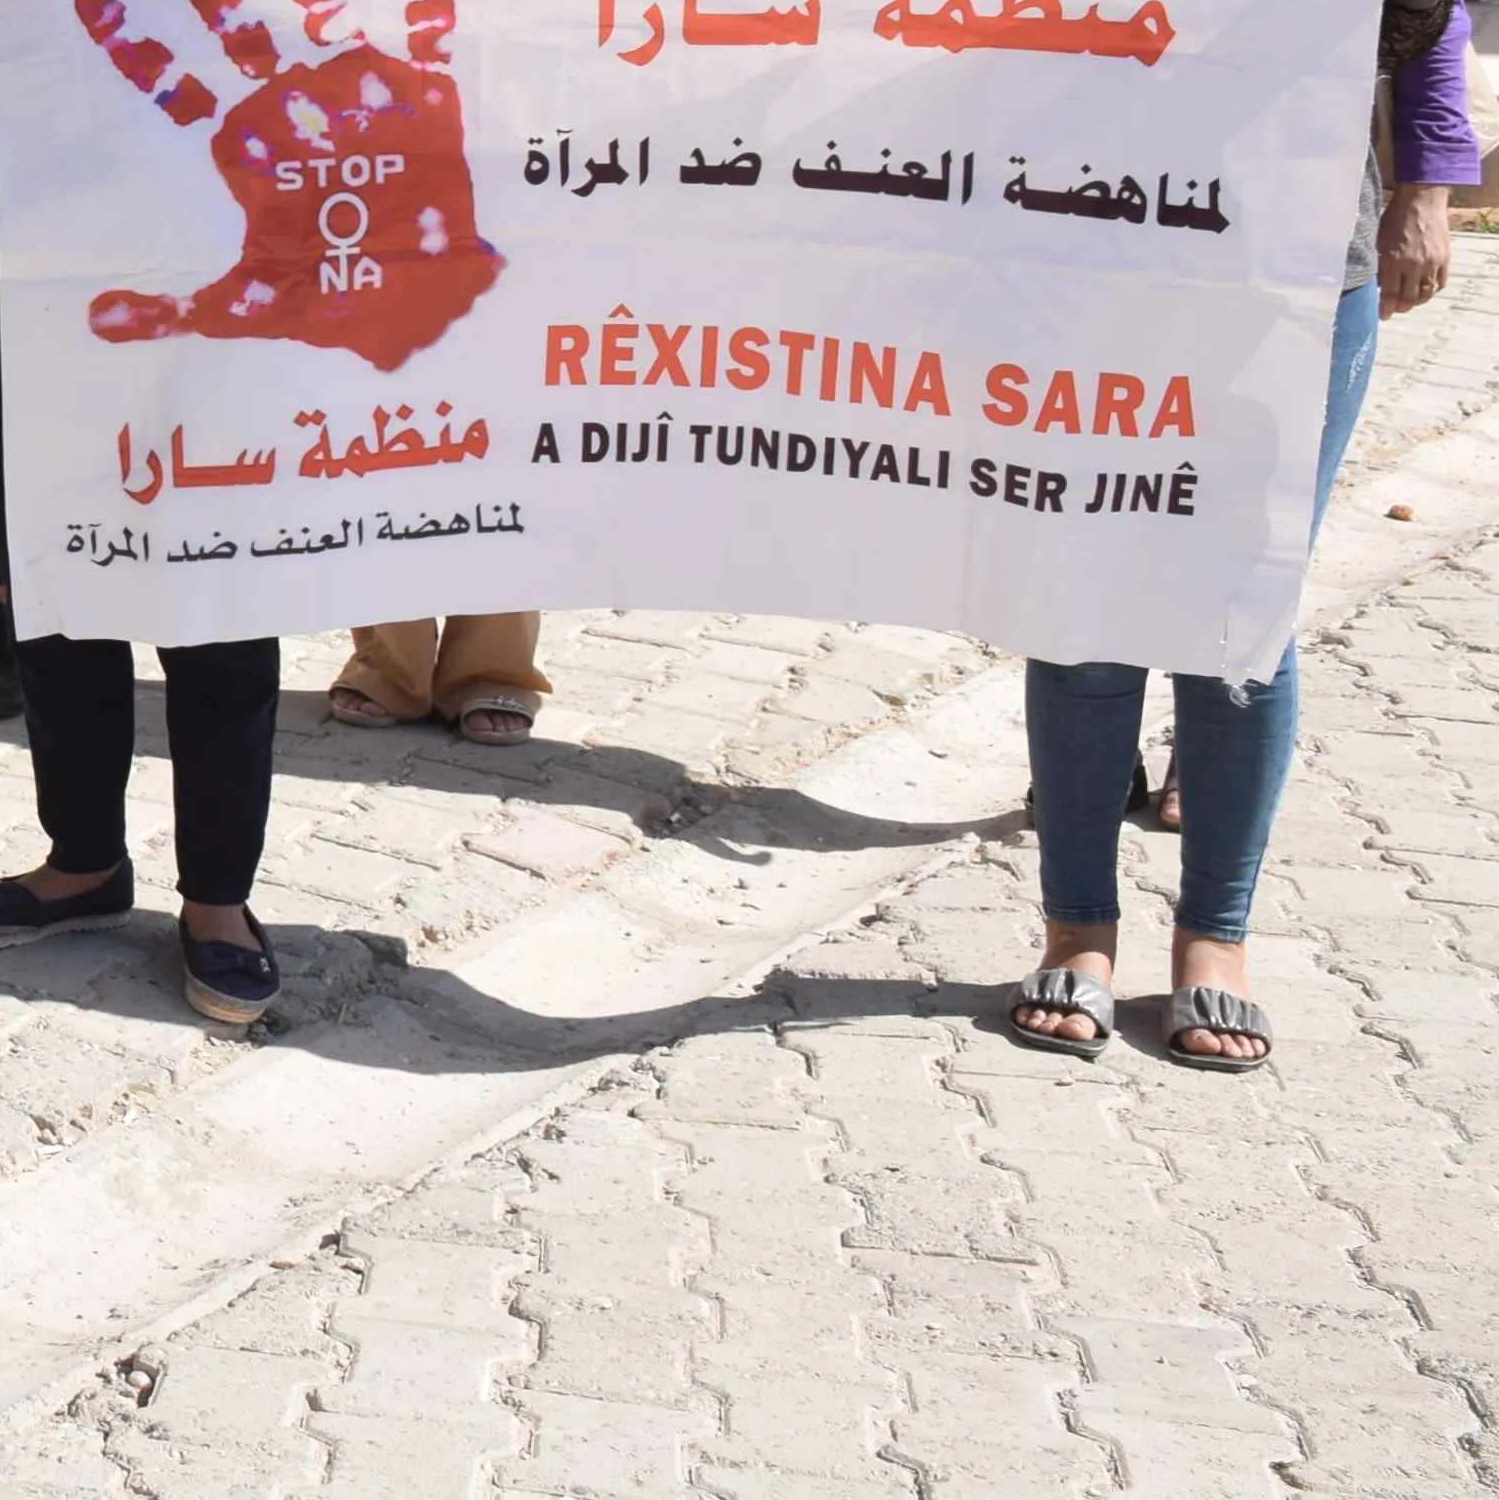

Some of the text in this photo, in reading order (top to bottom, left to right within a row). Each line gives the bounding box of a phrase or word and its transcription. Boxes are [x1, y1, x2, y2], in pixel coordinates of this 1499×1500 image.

[275, 154, 406, 192] STOP
[679, 137, 762, 187] ضد
[792, 140, 975, 206] العنف
[1002, 155, 1231, 235] لمناهضة
[318, 255, 383, 296] NA
[545, 303, 1195, 439] RÊXISTINA SARA
[118, 400, 491, 505] منظمة سارا
[531, 412, 1199, 517] A DIJÎ TUNDIYALI SER JINÊ
[250, 517, 364, 558] العنف
[375, 501, 525, 541] لمناهضة
[166, 530, 238, 563] ضد
